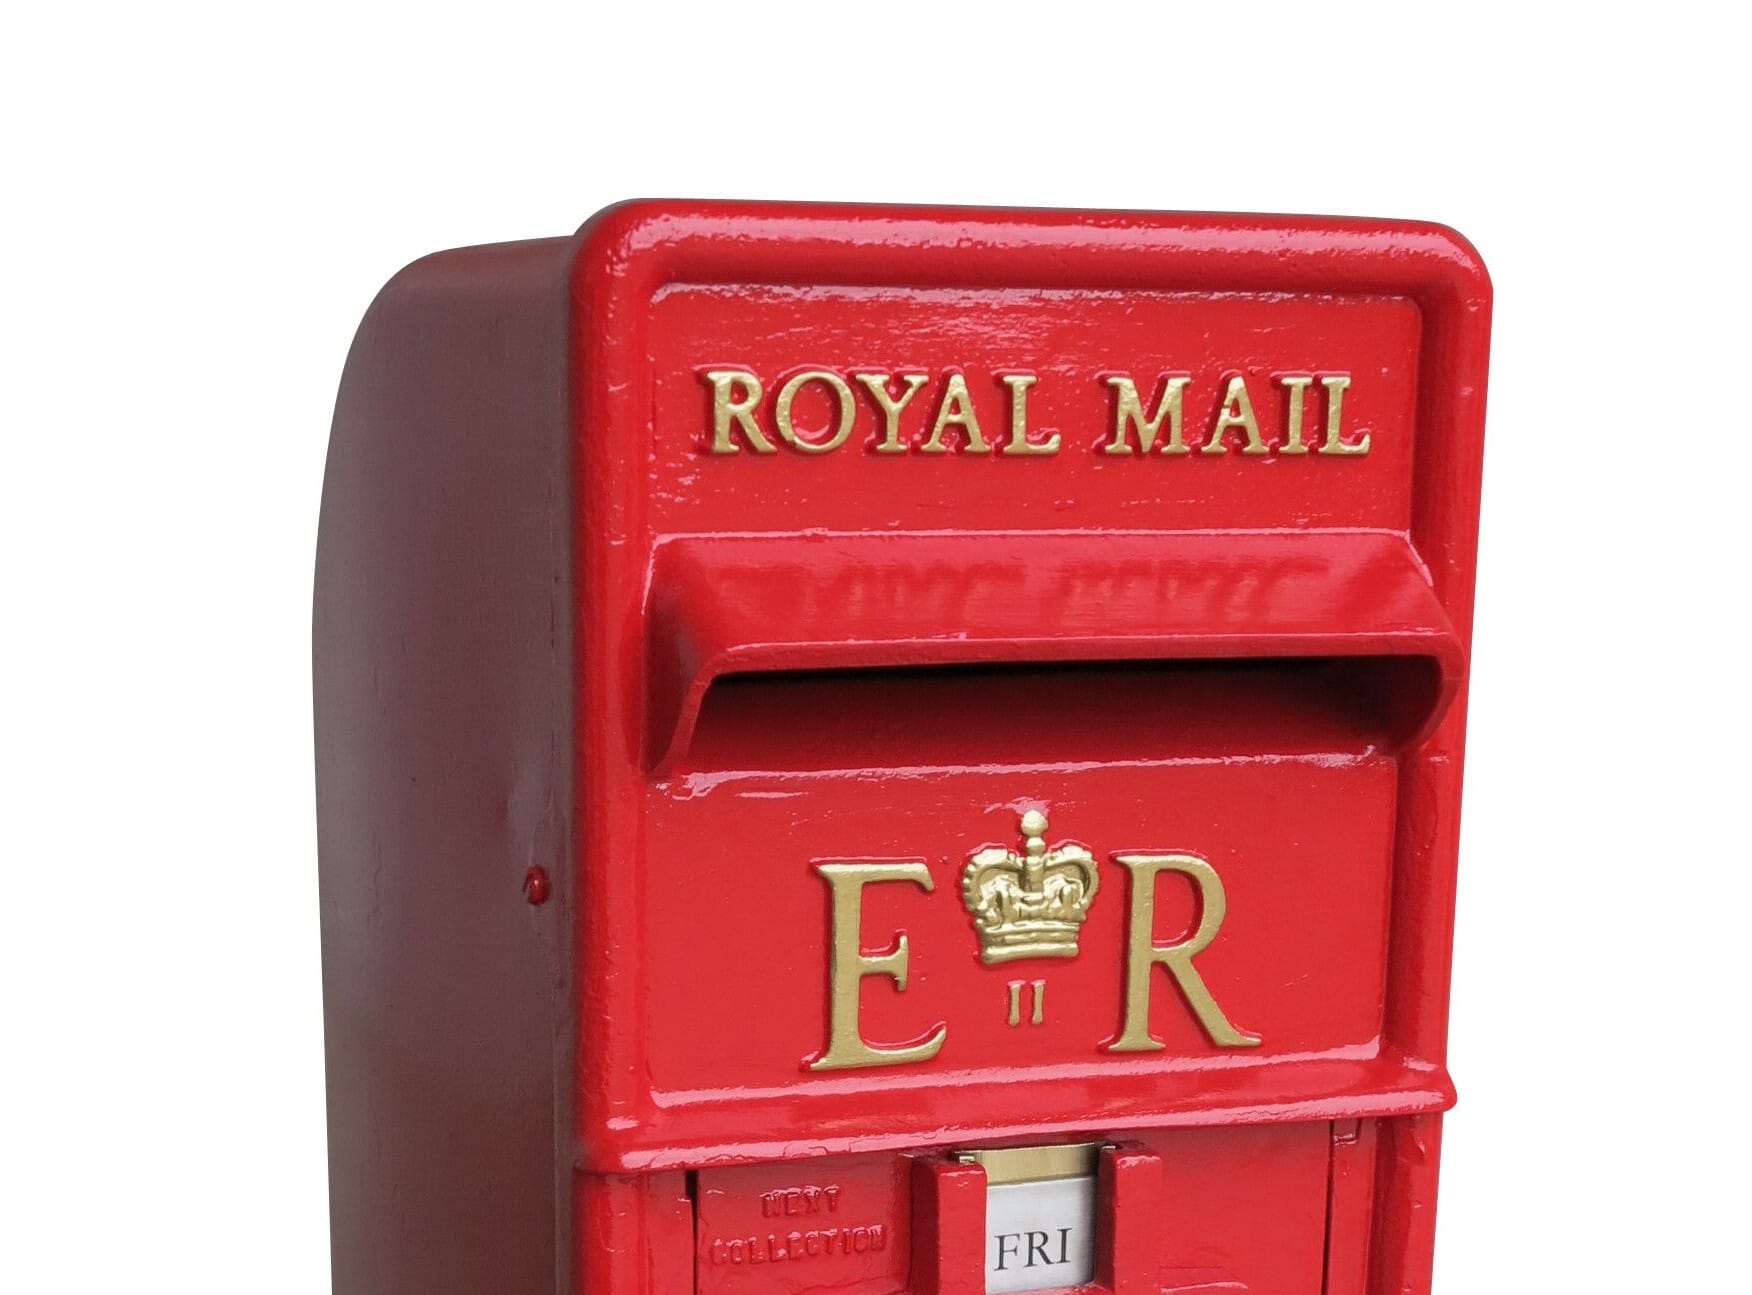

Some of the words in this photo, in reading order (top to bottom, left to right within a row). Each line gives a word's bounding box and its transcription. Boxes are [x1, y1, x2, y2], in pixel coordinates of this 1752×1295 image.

[706, 370, 1063, 456] ROYAL
[1104, 375, 1372, 456] MAIL
[808, 860, 948, 1071] E
[1106, 853, 1262, 1052] R
[1007, 980, 1046, 1026] II
[760, 1184, 840, 1218] NEXT
[711, 1225, 888, 1265] COLLECTION
[993, 1227, 1073, 1272] FRI
